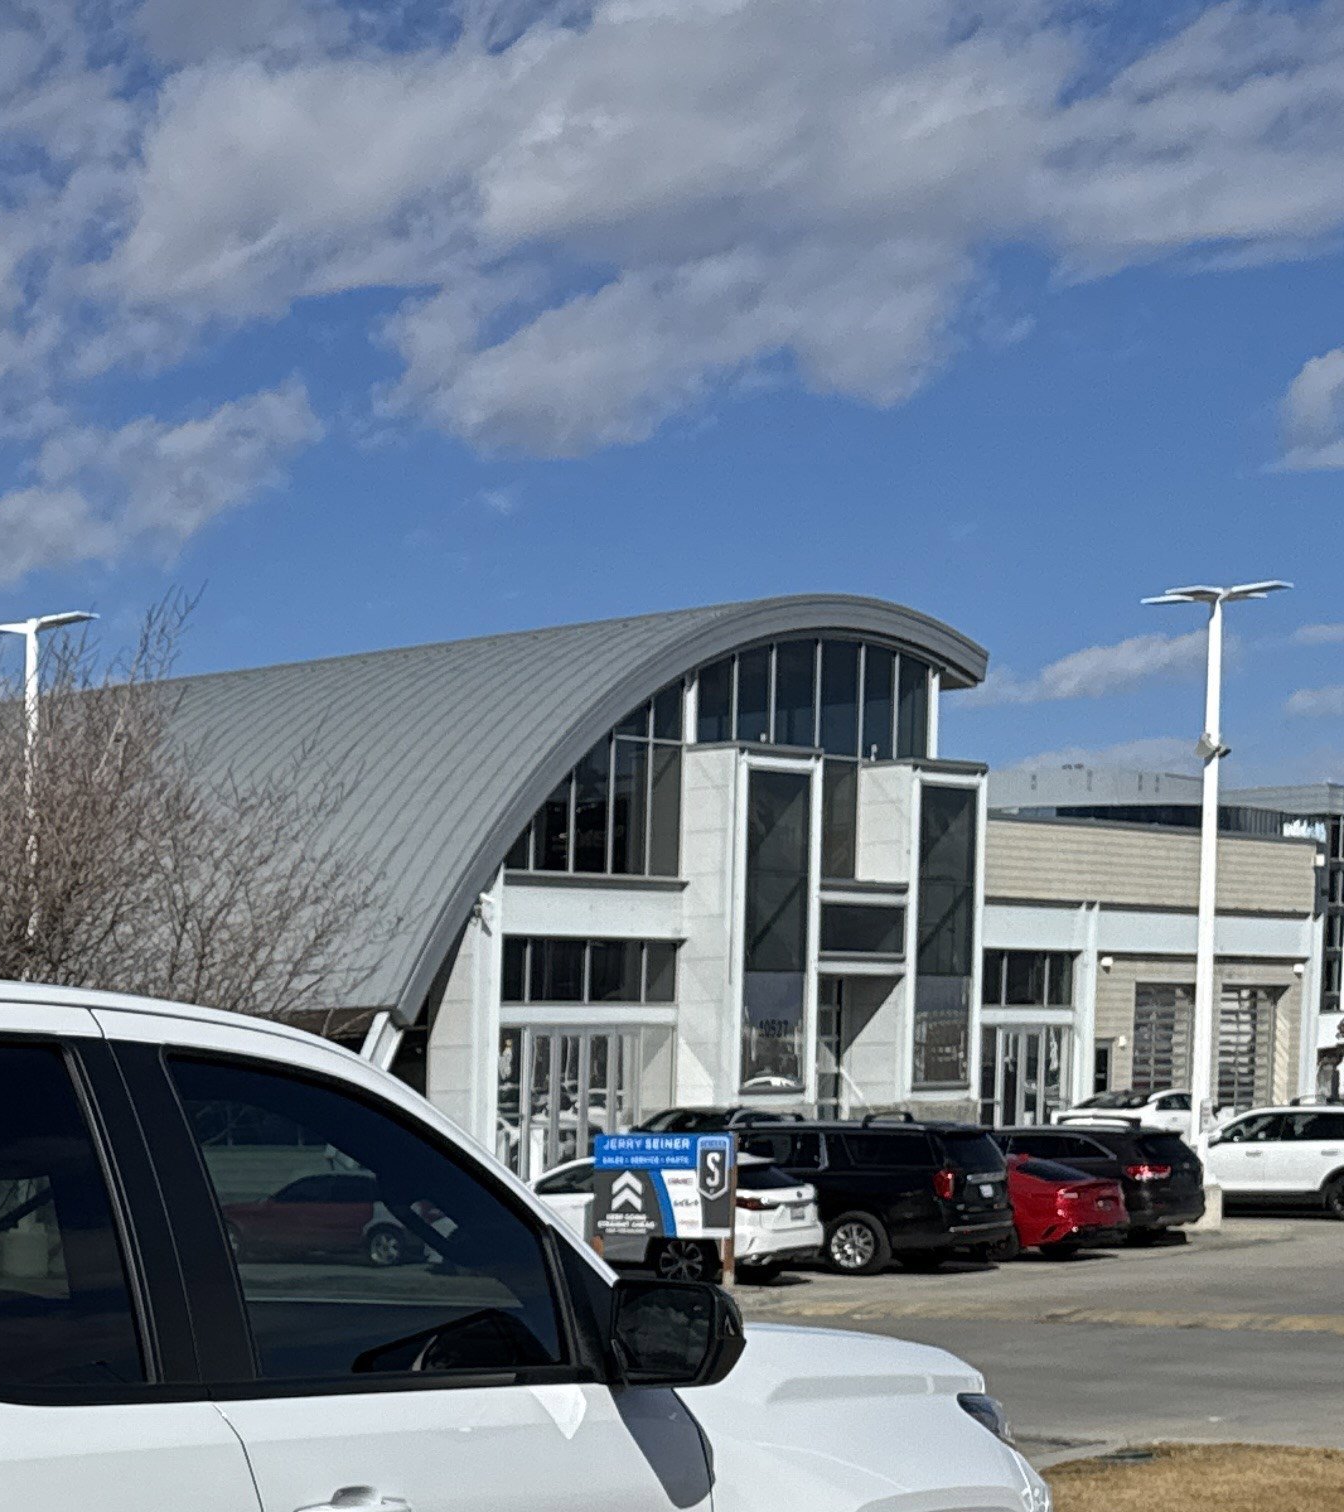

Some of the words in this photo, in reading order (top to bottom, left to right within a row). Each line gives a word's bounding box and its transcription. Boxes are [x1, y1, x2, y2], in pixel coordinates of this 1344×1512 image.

[603, 1138, 643, 1151] JERRY
[645, 1137, 691, 1151] SEINER
[705, 1151, 721, 1188] S
